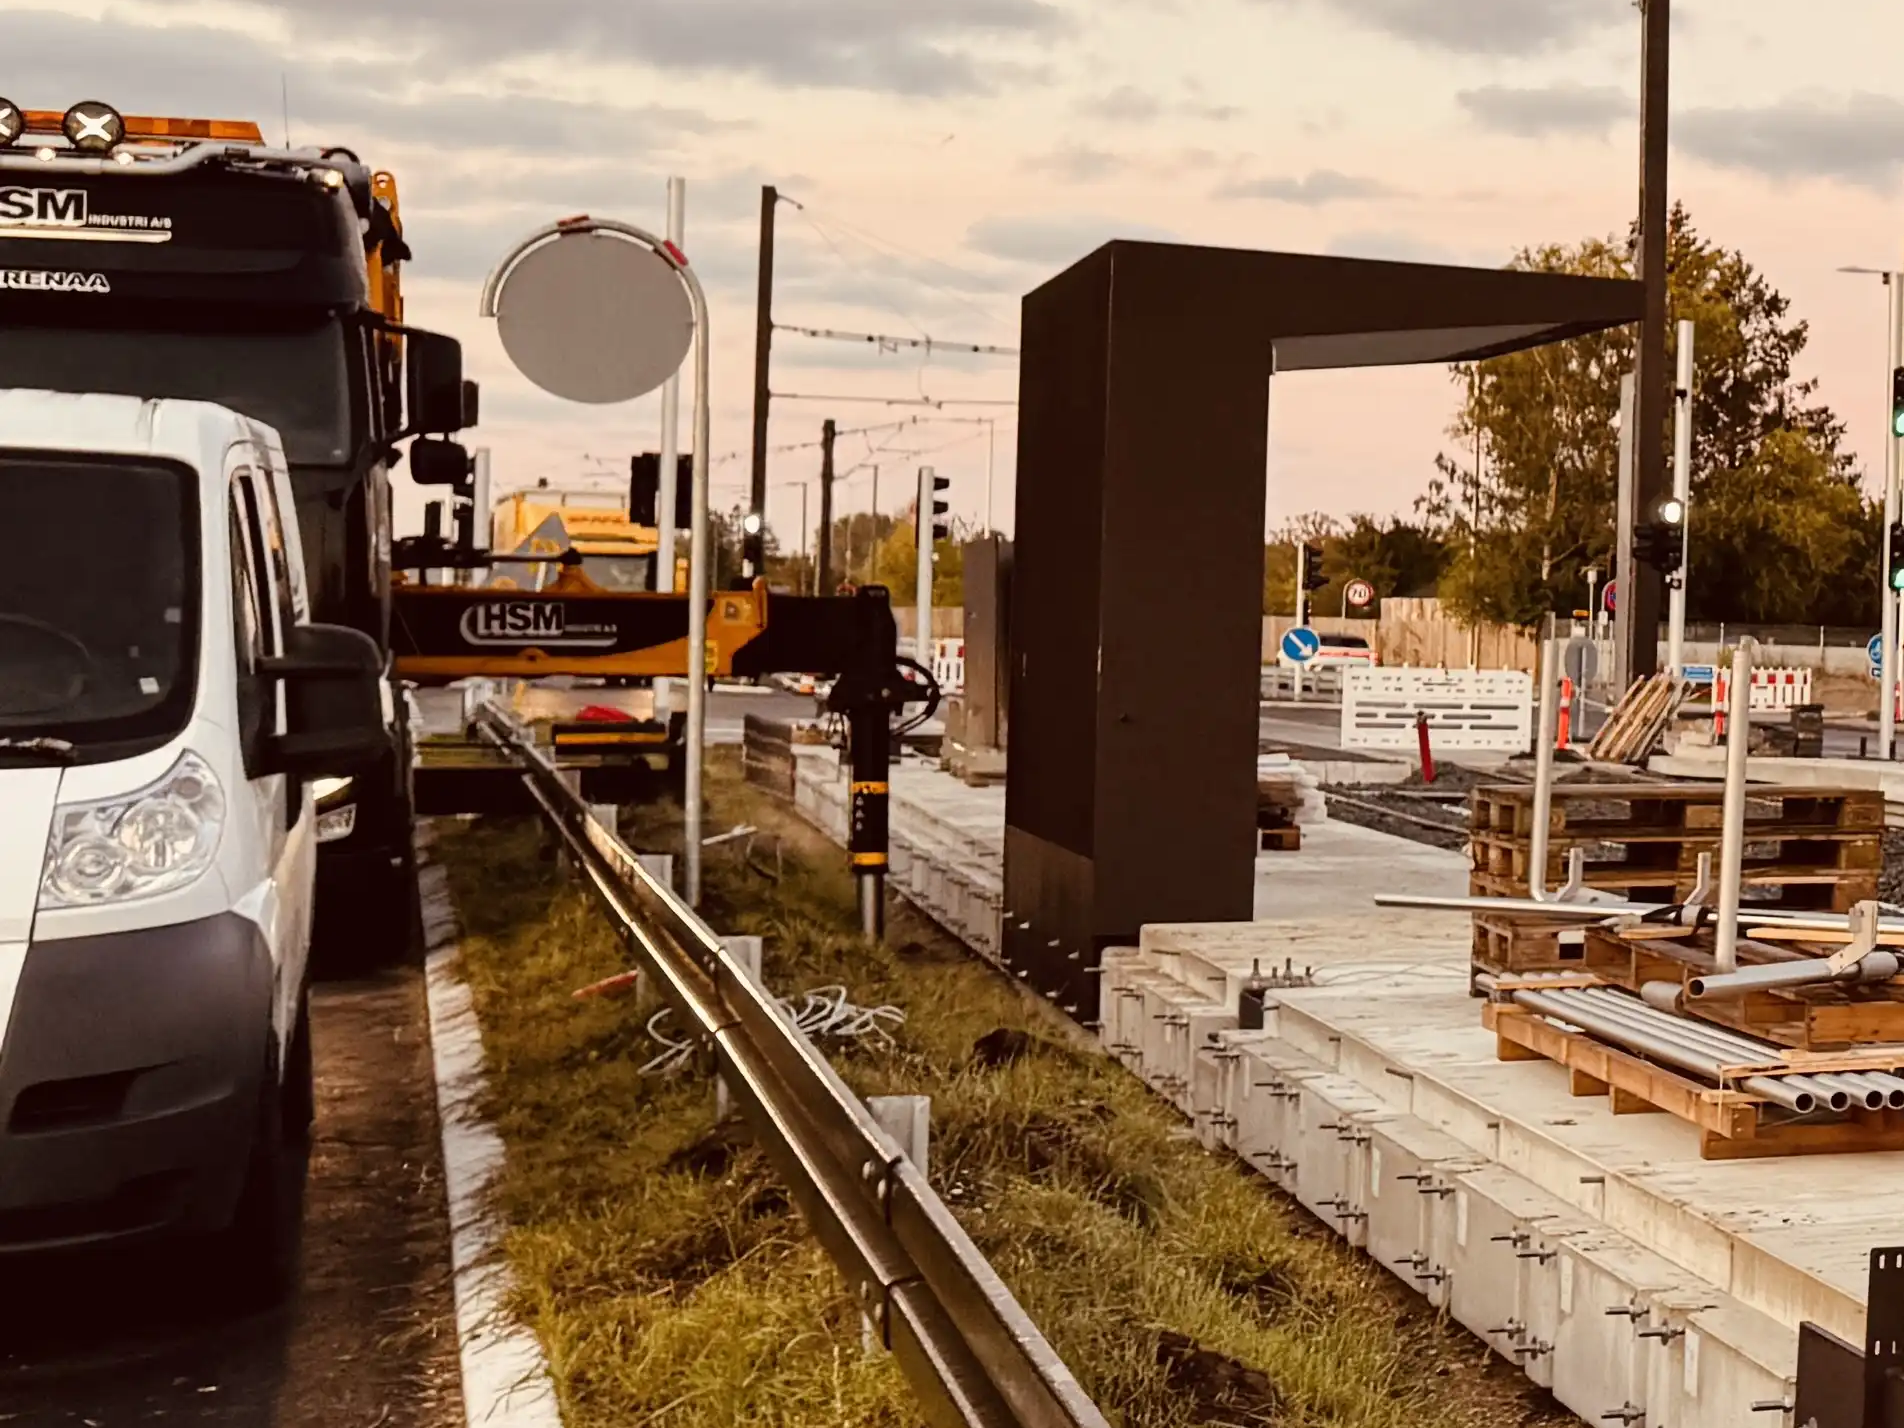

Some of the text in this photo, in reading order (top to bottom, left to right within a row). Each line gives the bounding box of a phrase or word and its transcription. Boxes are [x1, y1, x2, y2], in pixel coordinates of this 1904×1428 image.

[88, 213, 148, 228] INDUSTRI
[1351, 587, 1367, 598] 70
[478, 603, 564, 635] HSM
